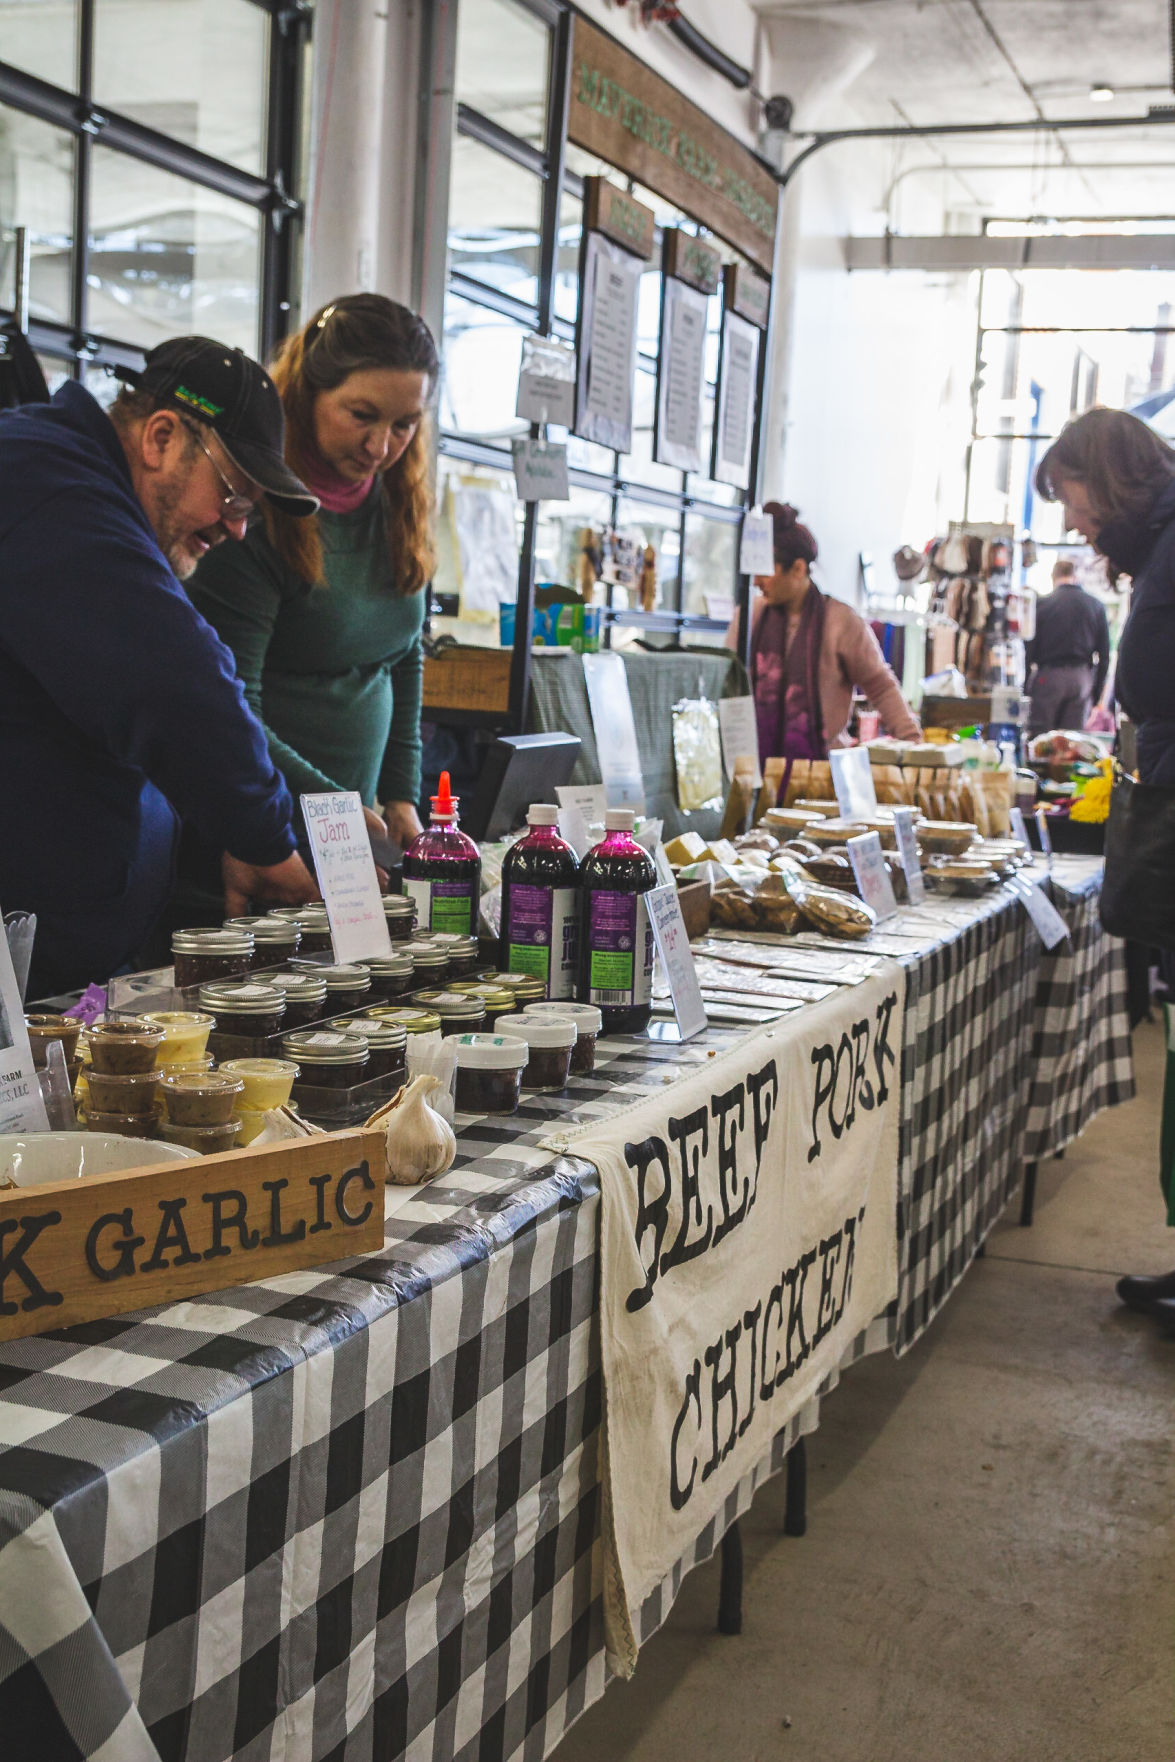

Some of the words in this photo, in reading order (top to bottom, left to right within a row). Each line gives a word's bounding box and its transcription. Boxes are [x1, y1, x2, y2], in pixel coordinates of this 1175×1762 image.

[808, 991, 897, 1164] PORK
[85, 1159, 375, 1282] GARLIC
[624, 1059, 778, 1313] BEEF
